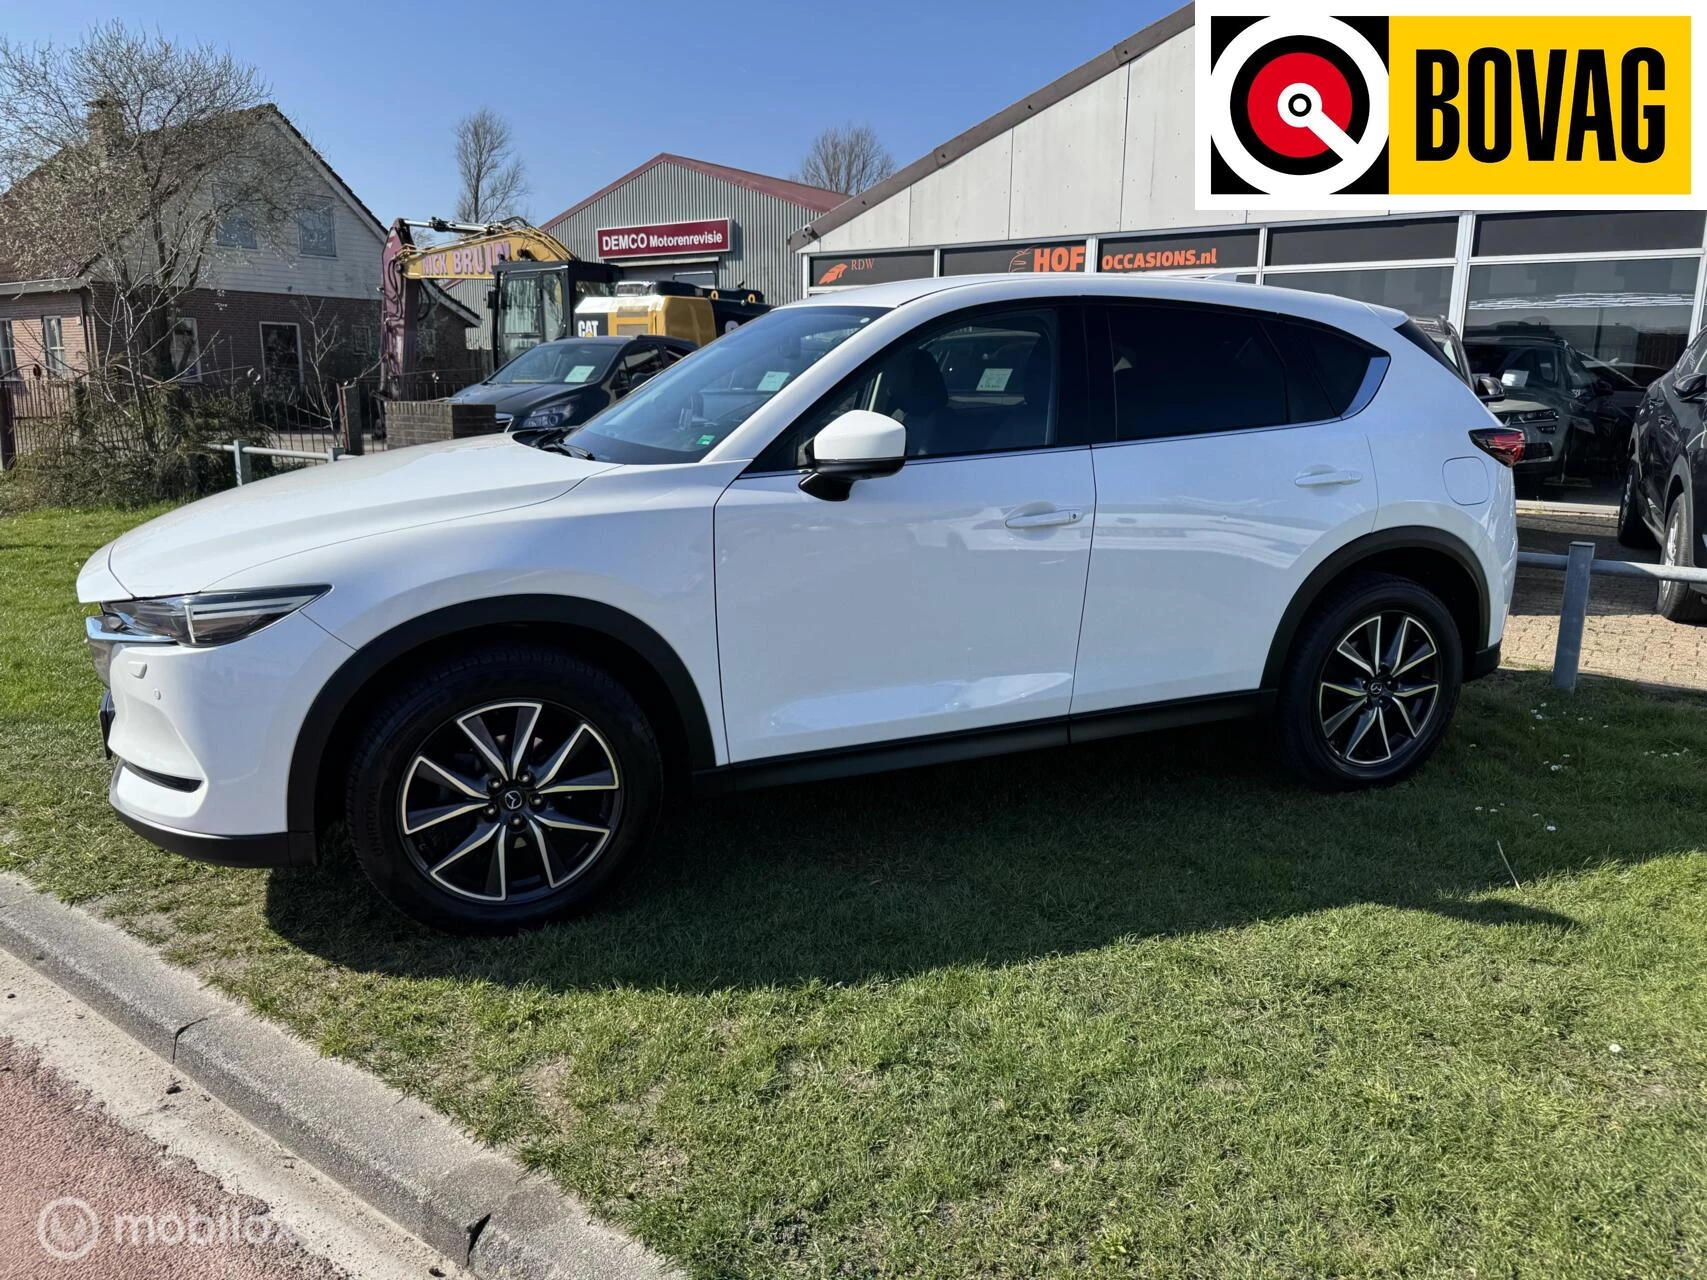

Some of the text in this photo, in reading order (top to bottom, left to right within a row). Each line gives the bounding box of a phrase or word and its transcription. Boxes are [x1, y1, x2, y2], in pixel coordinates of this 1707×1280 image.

[602, 230, 723, 251] DEMCO Motorenrevisie
[851, 258, 875, 271] RDW
[1033, 247, 1217, 273] HOF OCCASIONS.nl
[577, 320, 599, 337] CAT
[366, 785, 384, 857] UNIROYAL
